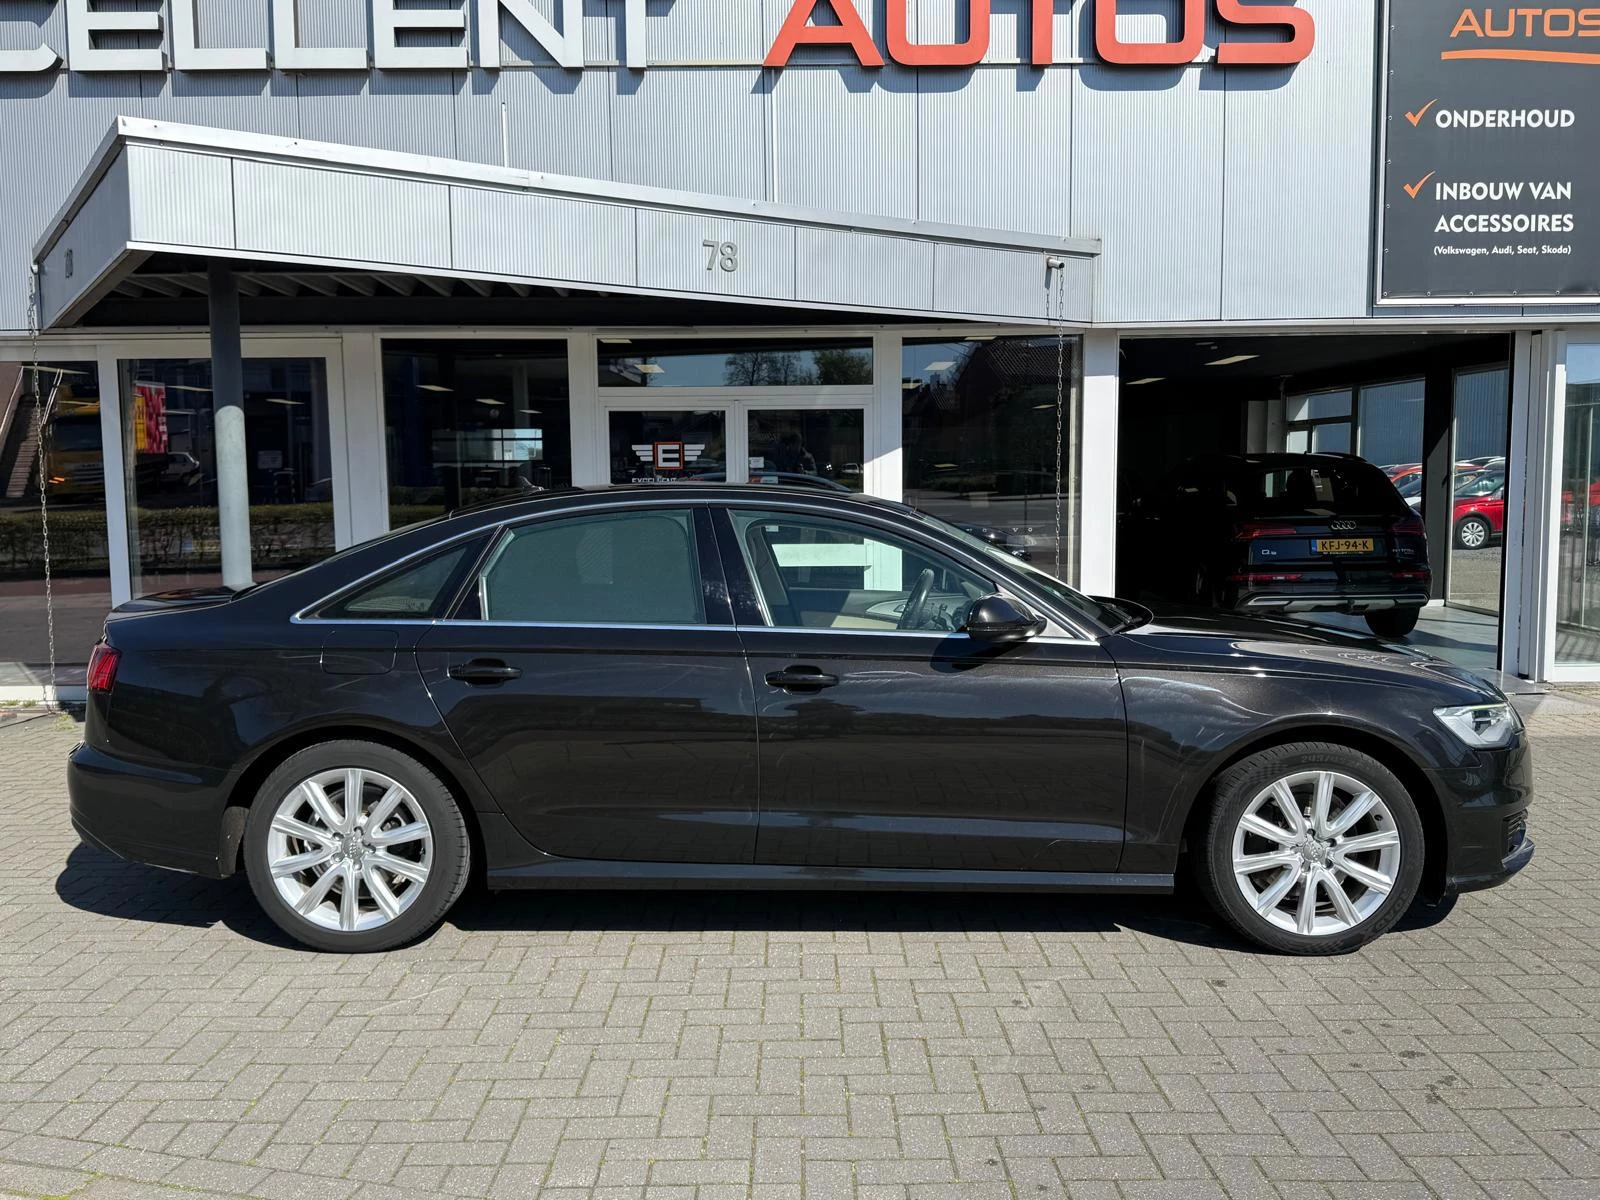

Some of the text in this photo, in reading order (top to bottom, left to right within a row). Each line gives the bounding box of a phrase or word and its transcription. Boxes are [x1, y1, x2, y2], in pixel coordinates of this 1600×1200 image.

[1450, 8, 1600, 37] AUTOS
[1435, 109, 1575, 128] ONDERHOUD
[1435, 181, 1572, 201] INBOUW VAN
[1434, 214, 1574, 233] ACCESSOIRES
[702, 239, 738, 272] 78
[1433, 244, 1572, 256] (Volkswagen, Audi, Seat, Skoda)
[657, 444, 680, 468] E
[1321, 540, 1369, 550] KFJ-94-K
